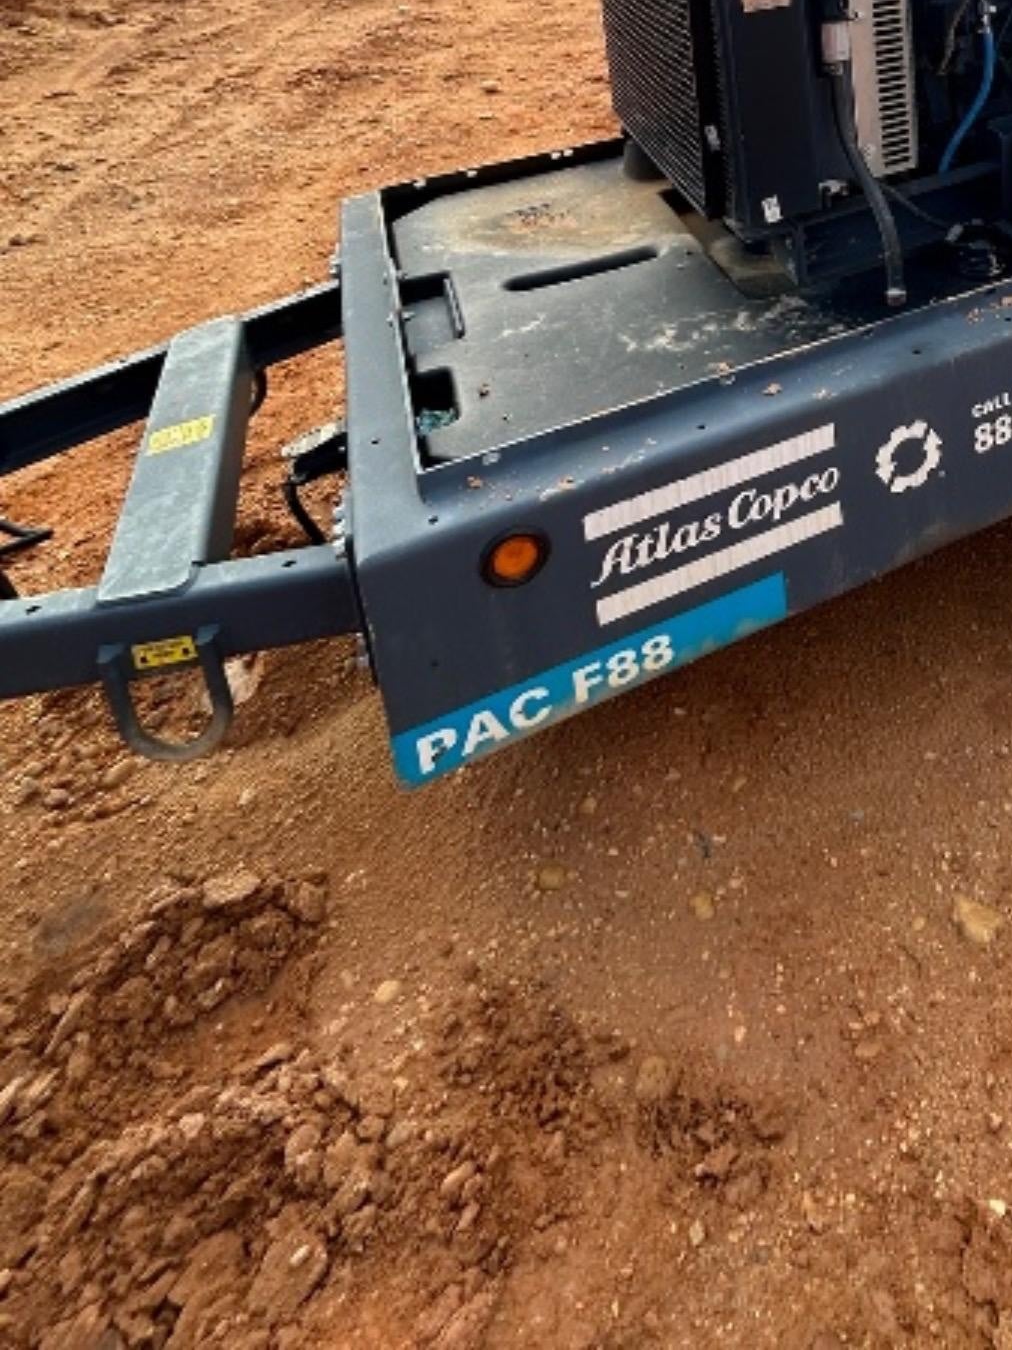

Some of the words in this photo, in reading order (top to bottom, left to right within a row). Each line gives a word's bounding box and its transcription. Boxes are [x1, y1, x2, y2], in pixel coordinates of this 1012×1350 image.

[971, 393, 1011, 418] CALL
[590, 512, 722, 588] Atlas
[728, 467, 841, 529] Copco
[416, 686, 553, 775] PAC
[572, 634, 674, 703] F88
